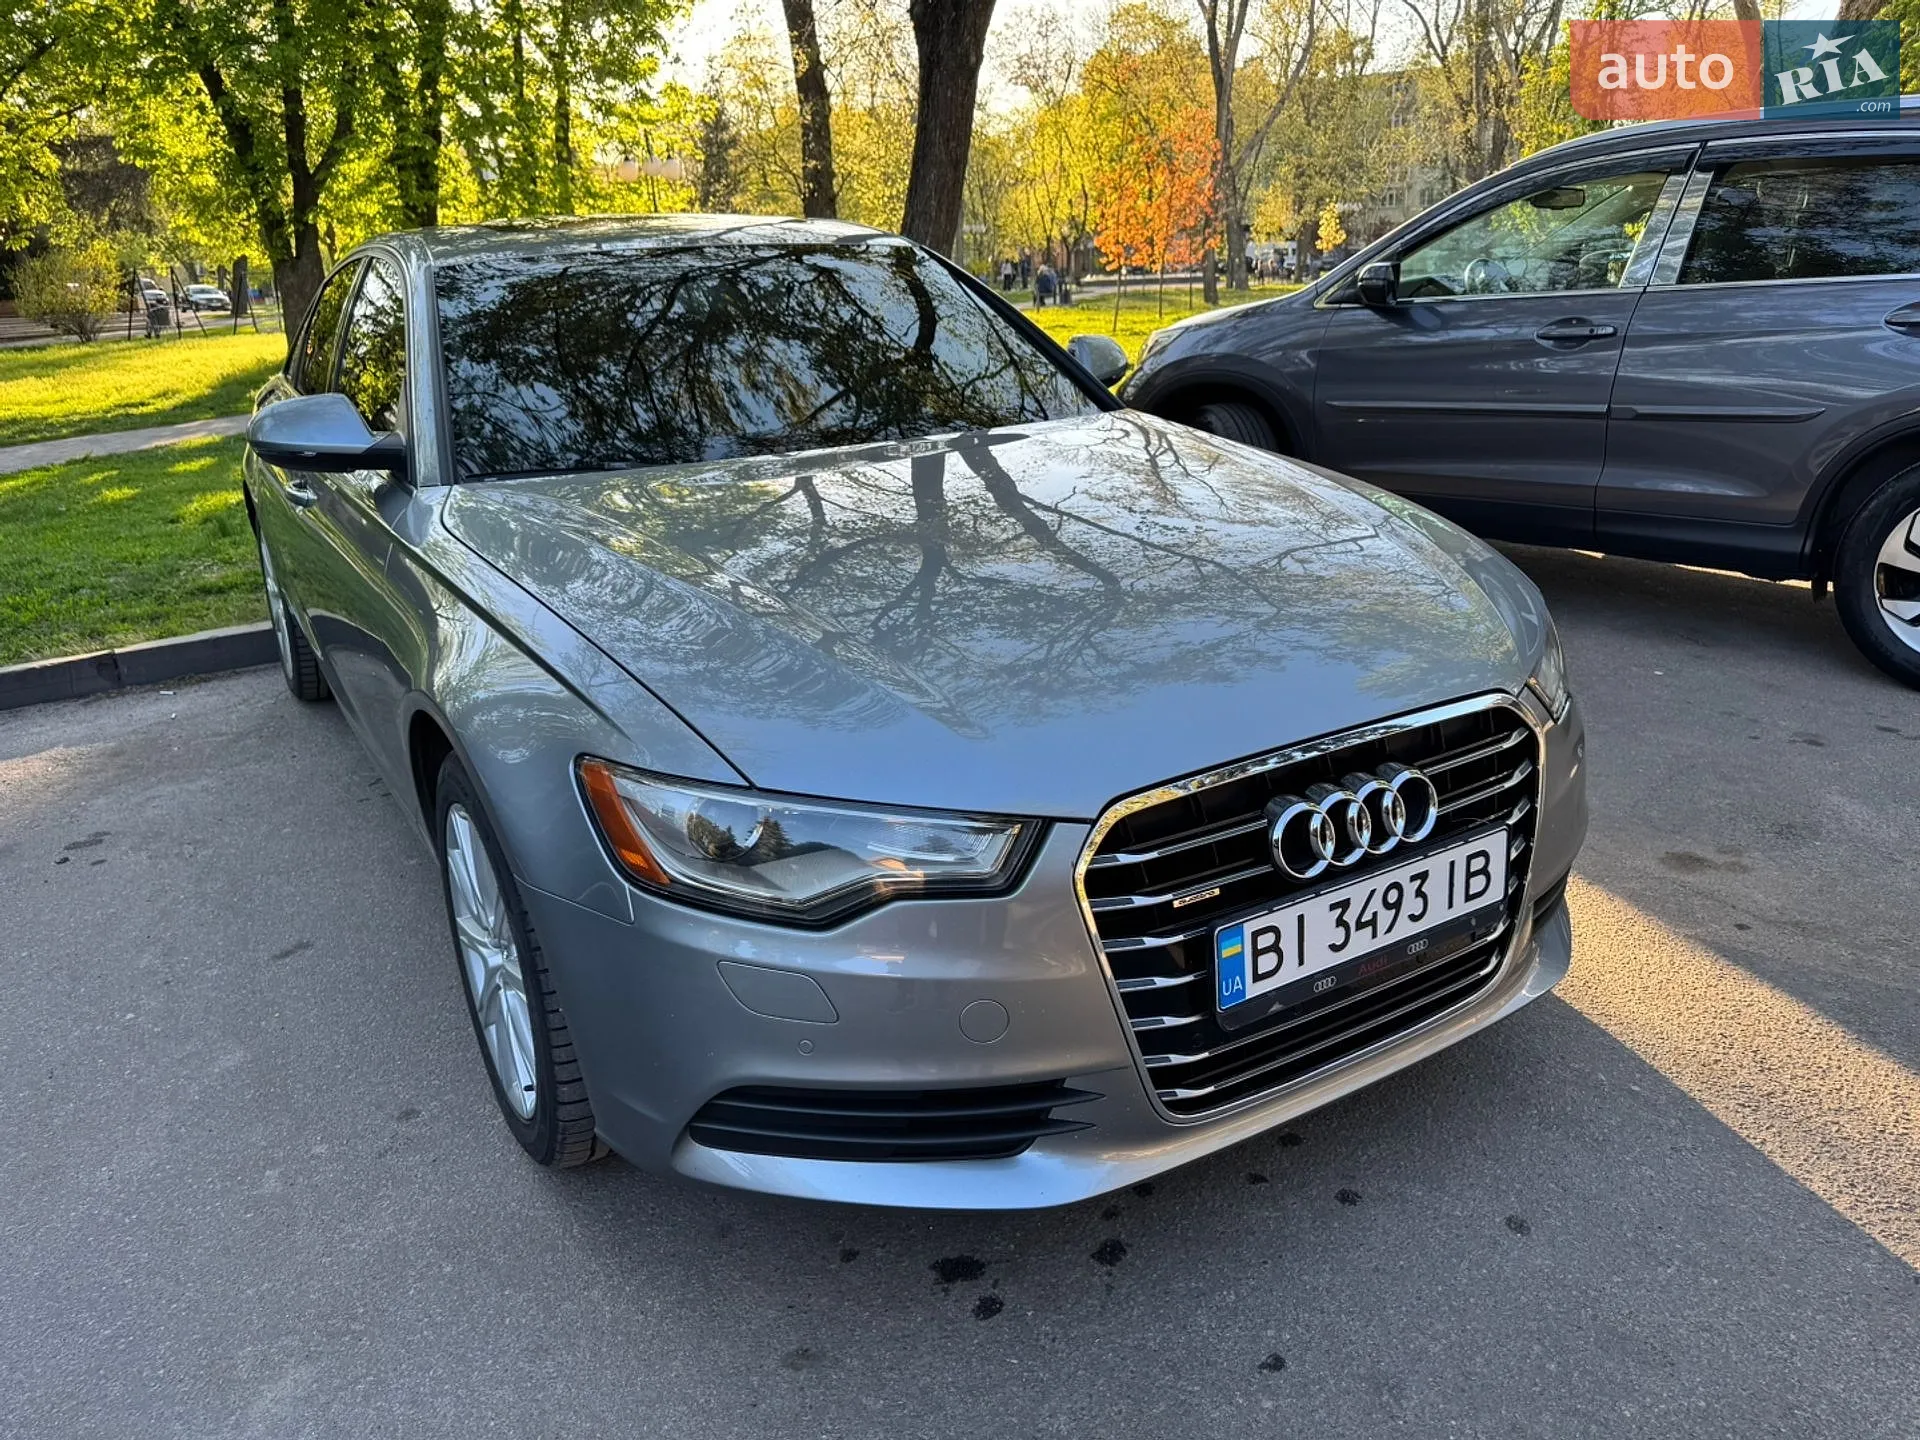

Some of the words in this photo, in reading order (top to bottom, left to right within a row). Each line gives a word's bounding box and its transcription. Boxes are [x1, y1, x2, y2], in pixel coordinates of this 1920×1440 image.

[1250, 913, 1305, 984] BI
[1328, 869, 1430, 953] 3493
[1448, 849, 1492, 910] IB
[1222, 976, 1243, 997] UA
